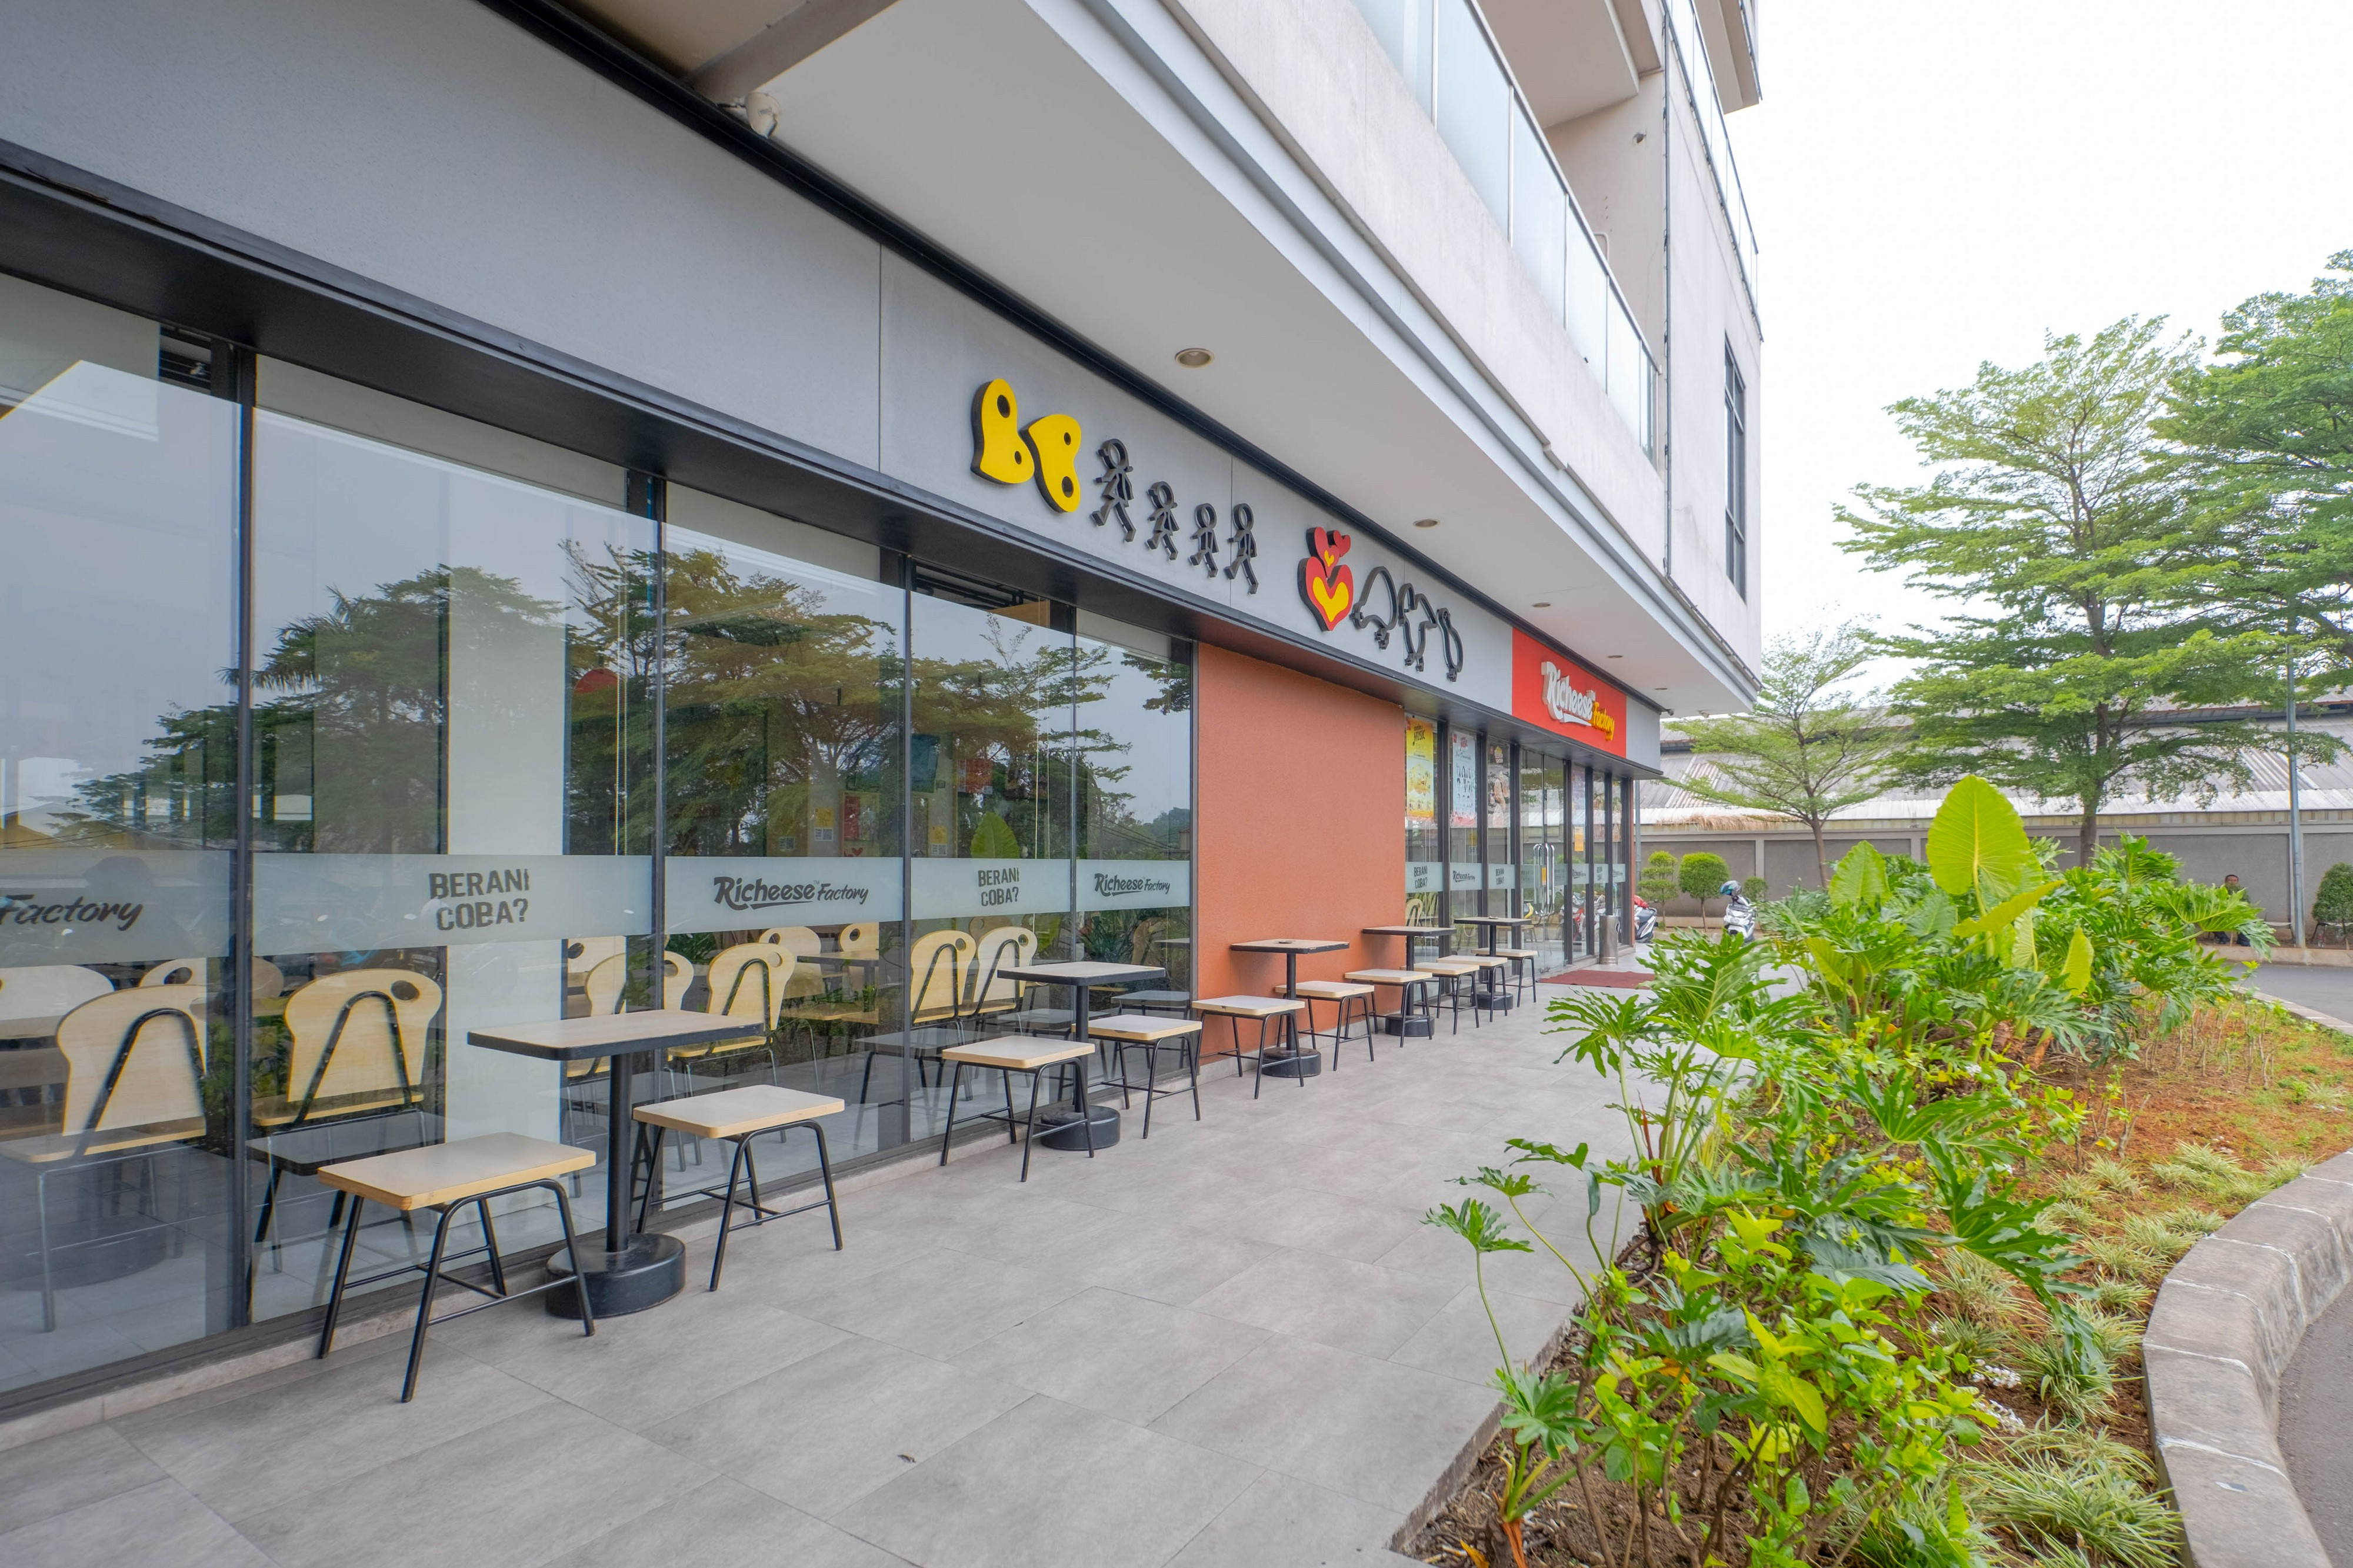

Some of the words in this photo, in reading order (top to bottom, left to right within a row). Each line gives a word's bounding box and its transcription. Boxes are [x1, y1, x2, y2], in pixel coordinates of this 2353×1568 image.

[1541, 661, 1593, 723] Richeese
[1592, 702, 1614, 741] Factory
[429, 868, 529, 899] BERANI
[978, 868, 1019, 887] BERANI
[1095, 873, 1144, 897] Richeese
[1144, 878, 1171, 895] Factory
[1414, 866, 1428, 877] BERANI
[1415, 878, 1428, 889] COBA?
[714, 876, 815, 911] Richeese
[817, 883, 869, 905] Factory
[981, 886, 1019, 906] COBA?
[0, 894, 144, 931] Factory
[436, 898, 529, 930] COBA?
